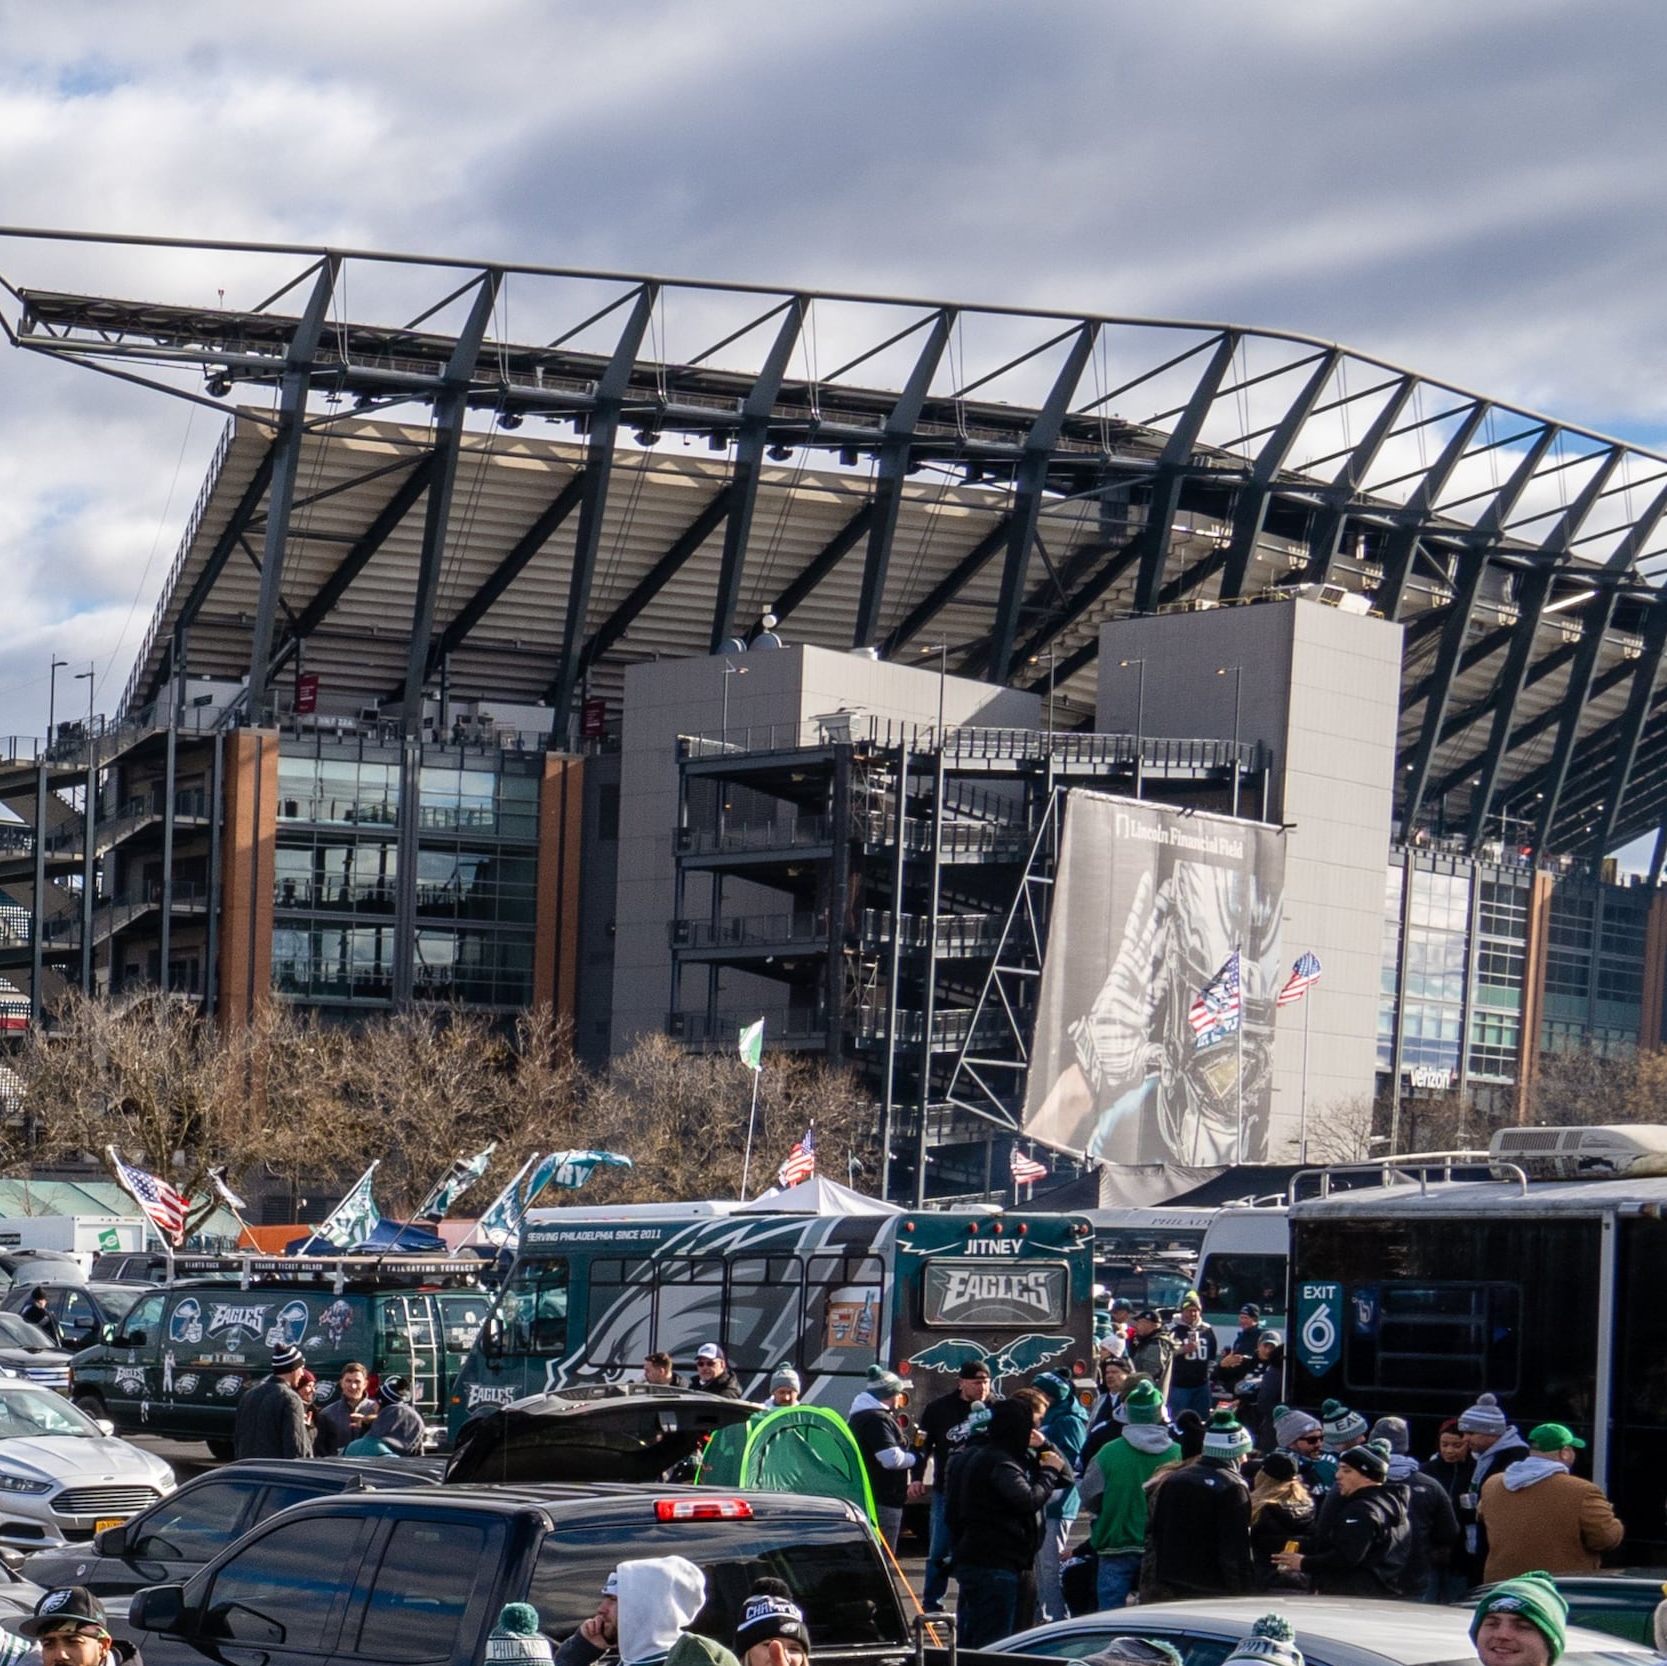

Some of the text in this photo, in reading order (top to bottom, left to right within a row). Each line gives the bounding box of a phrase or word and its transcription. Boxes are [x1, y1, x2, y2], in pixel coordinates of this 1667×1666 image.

[1410, 1066, 1451, 1090] verizon
[527, 1229, 661, 1242] SERVING PHILADELPHIA SINCE 2011
[963, 1238, 1023, 1255] JITNEY
[941, 1269, 1051, 1313] EAGLES
[1302, 1285, 1336, 1300] EXIT
[208, 1302, 275, 1334] EAGLES
[1302, 1302, 1335, 1353] 6
[466, 1384, 516, 1408] EAGLES
